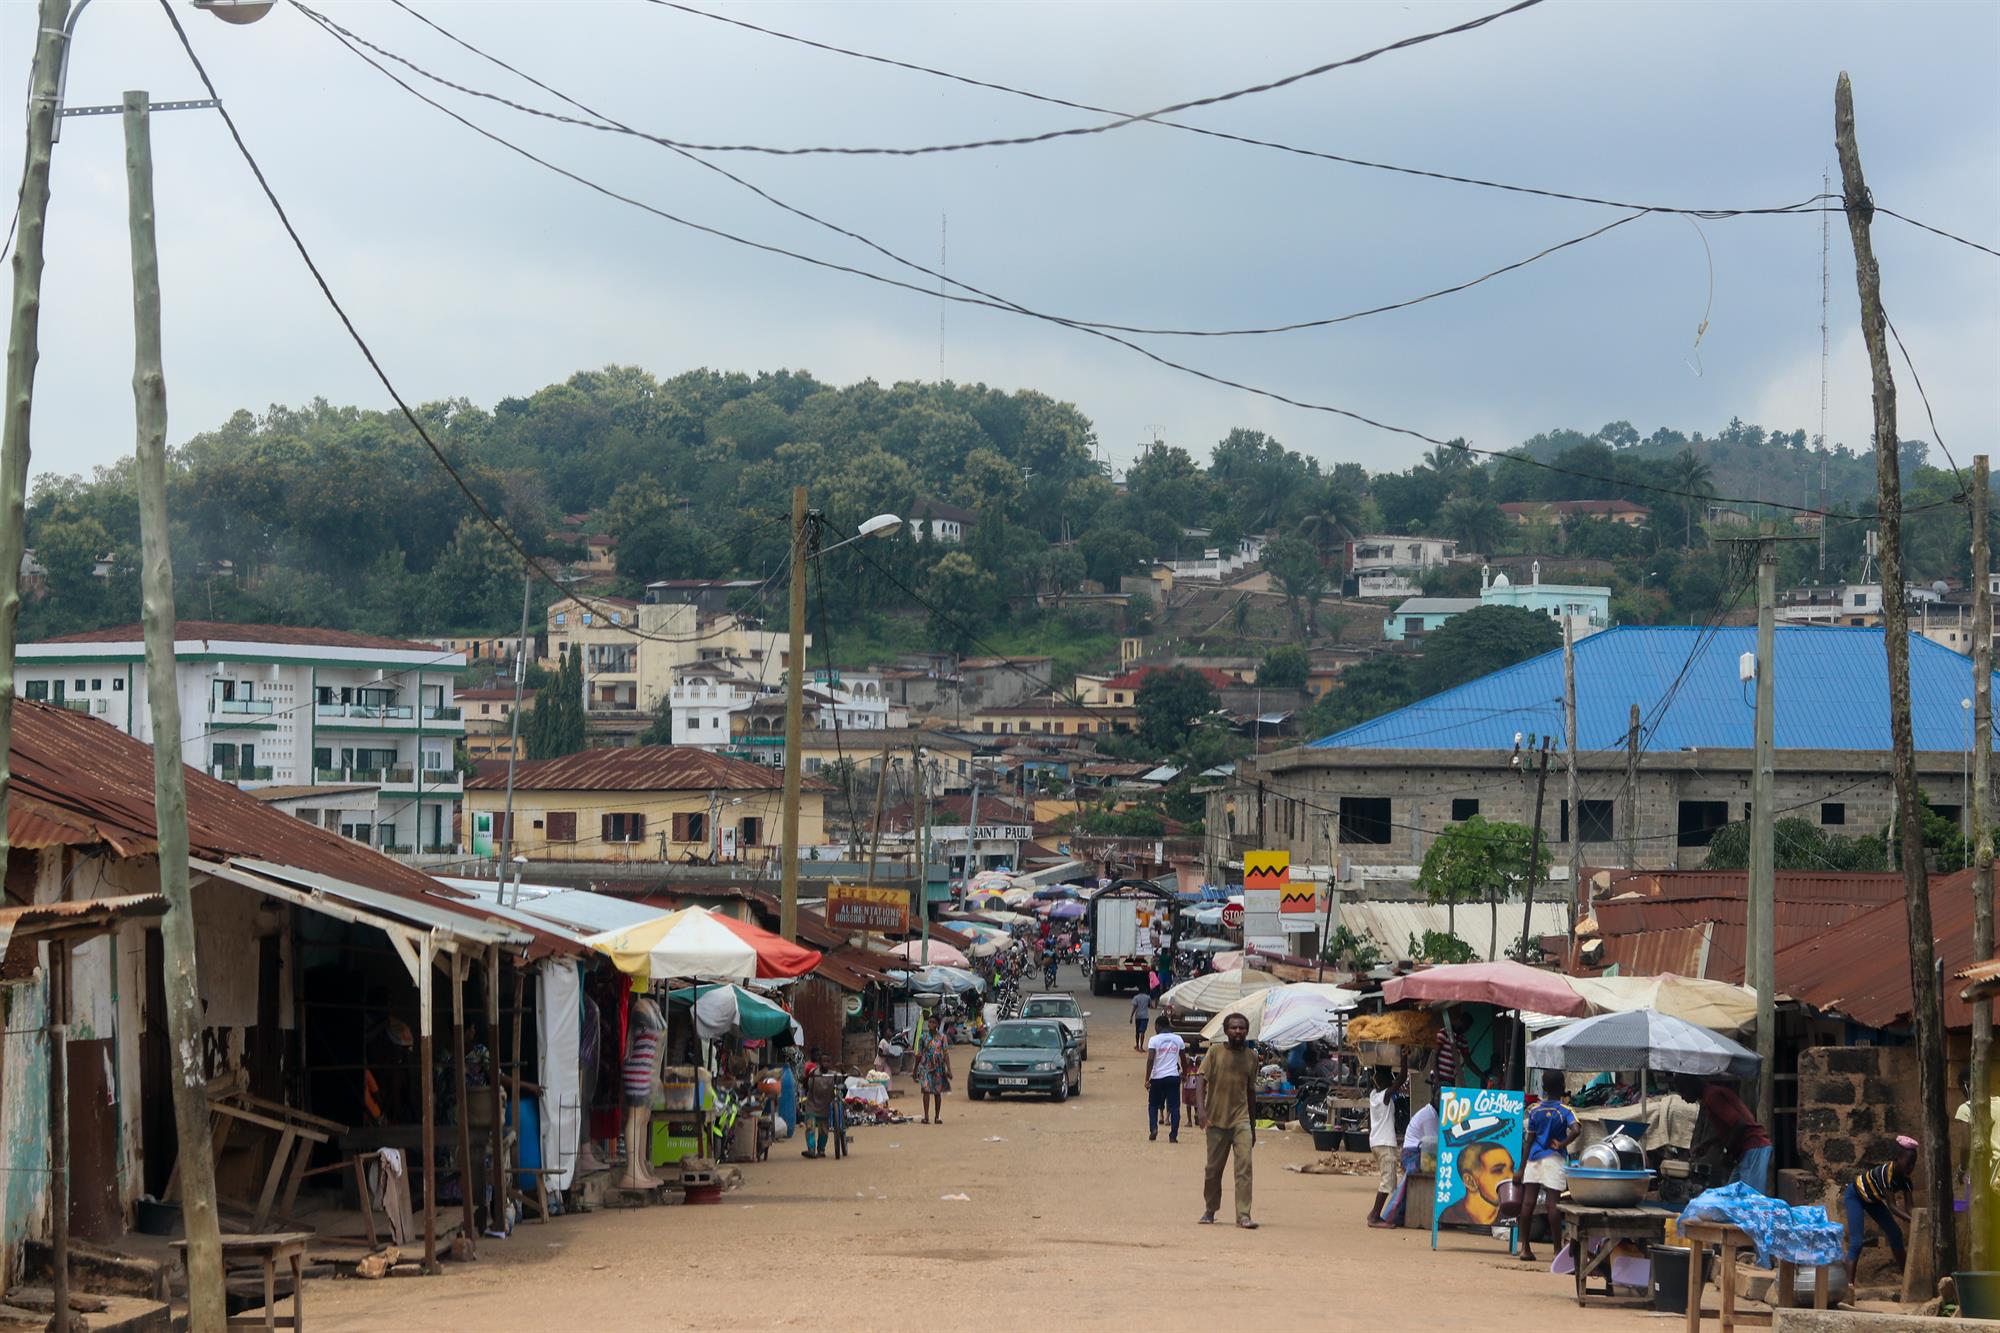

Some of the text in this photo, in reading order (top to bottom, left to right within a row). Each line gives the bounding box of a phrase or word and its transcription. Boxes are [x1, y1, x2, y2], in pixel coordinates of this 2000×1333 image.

[1005, 827, 1028, 839] PAUL
[1441, 1089, 1523, 1126] Top Coiffure
[1441, 1152, 1453, 1164] 90
